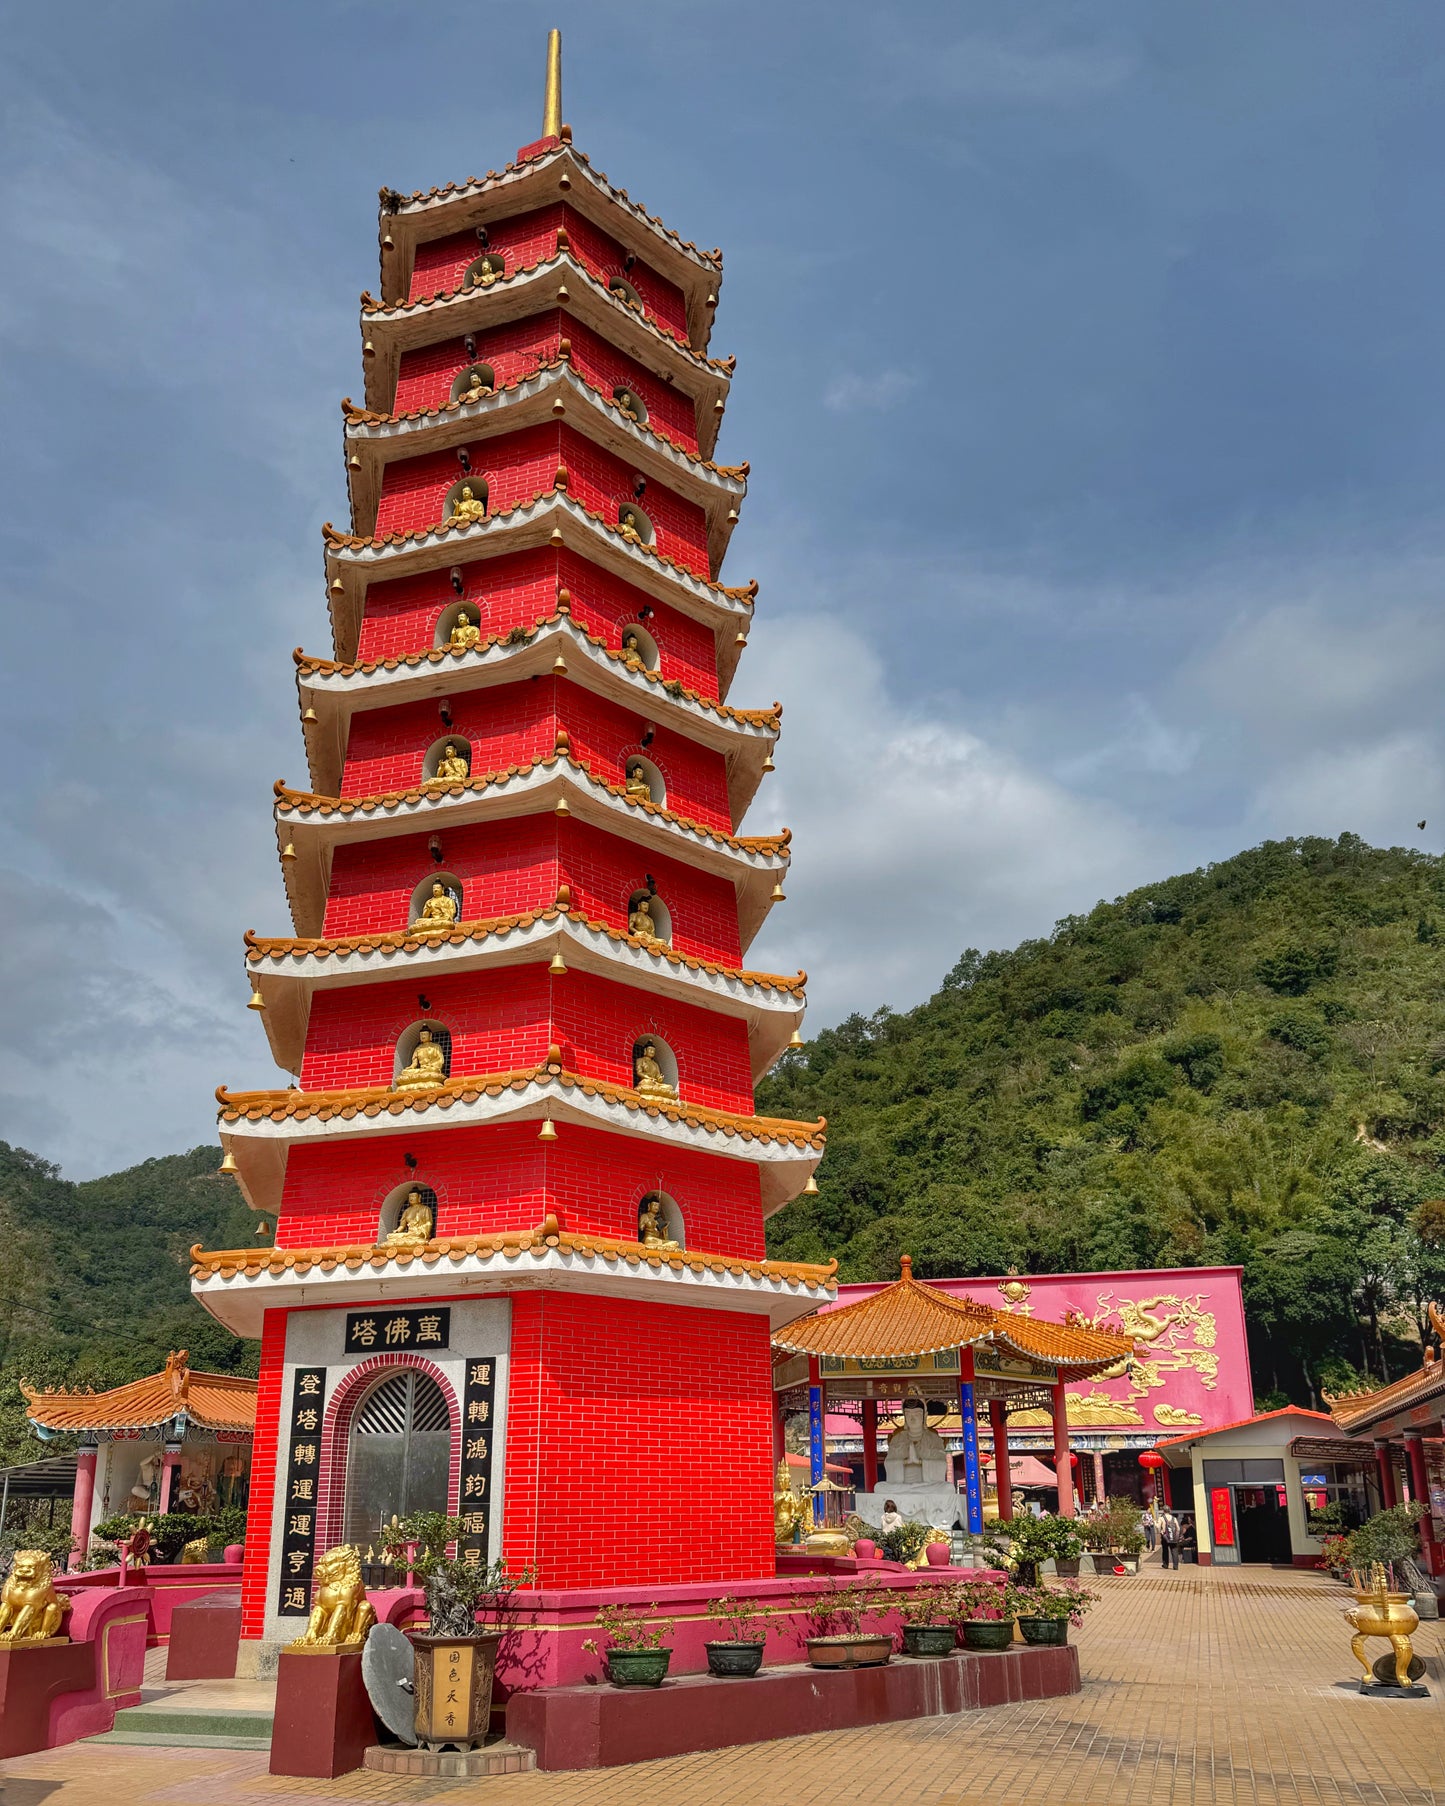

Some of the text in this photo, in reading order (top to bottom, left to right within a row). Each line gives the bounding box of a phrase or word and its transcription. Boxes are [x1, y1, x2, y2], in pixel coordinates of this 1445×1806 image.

[352, 1315, 441, 1345] 萬佛塔
[284, 1374, 320, 1609] 登塔轉運運亨通
